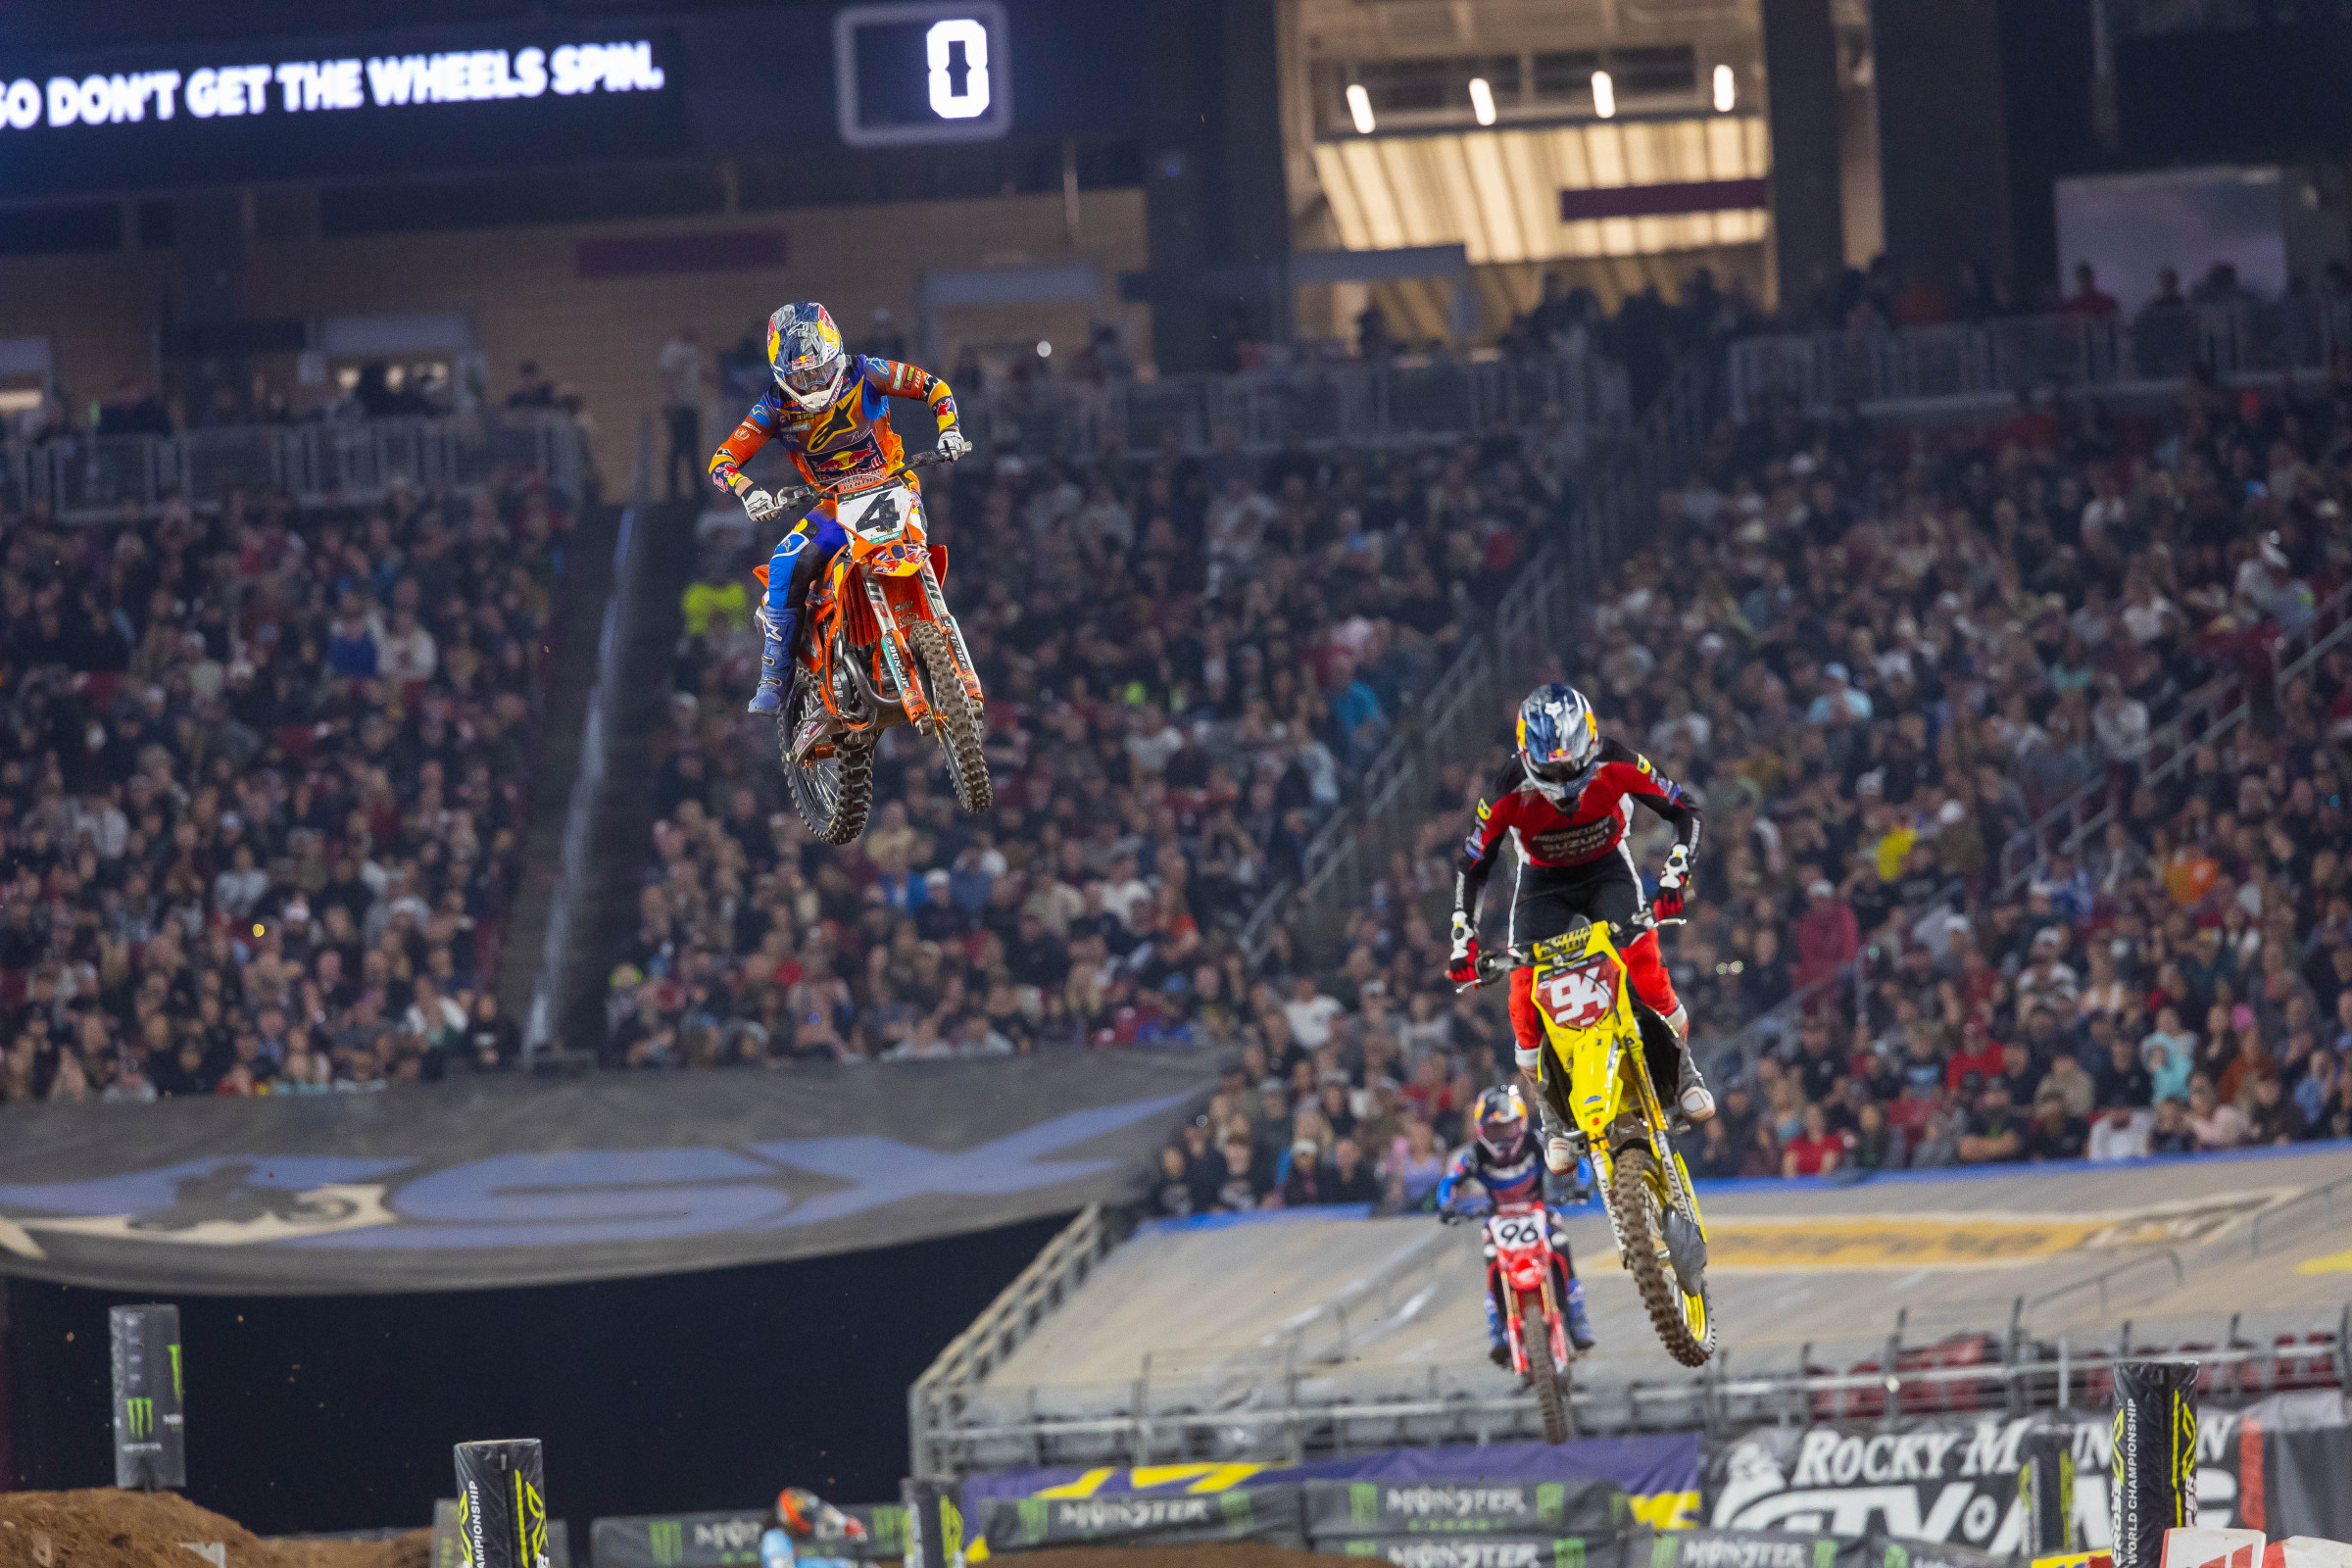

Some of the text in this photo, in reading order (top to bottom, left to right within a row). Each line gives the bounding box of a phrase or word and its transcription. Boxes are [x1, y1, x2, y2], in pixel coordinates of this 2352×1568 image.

[0, 40, 665, 130] O DON'T GET THE WHEELS SPIN.
[926, 18, 990, 120] 0
[856, 490, 901, 532] 4
[1549, 966, 1612, 1025] 94
[1500, 1223, 1539, 1245] 96
[1790, 1430, 1959, 1487] ROCKY
[2127, 1397, 2138, 1565] WORLD CHAMPIONSHIP
